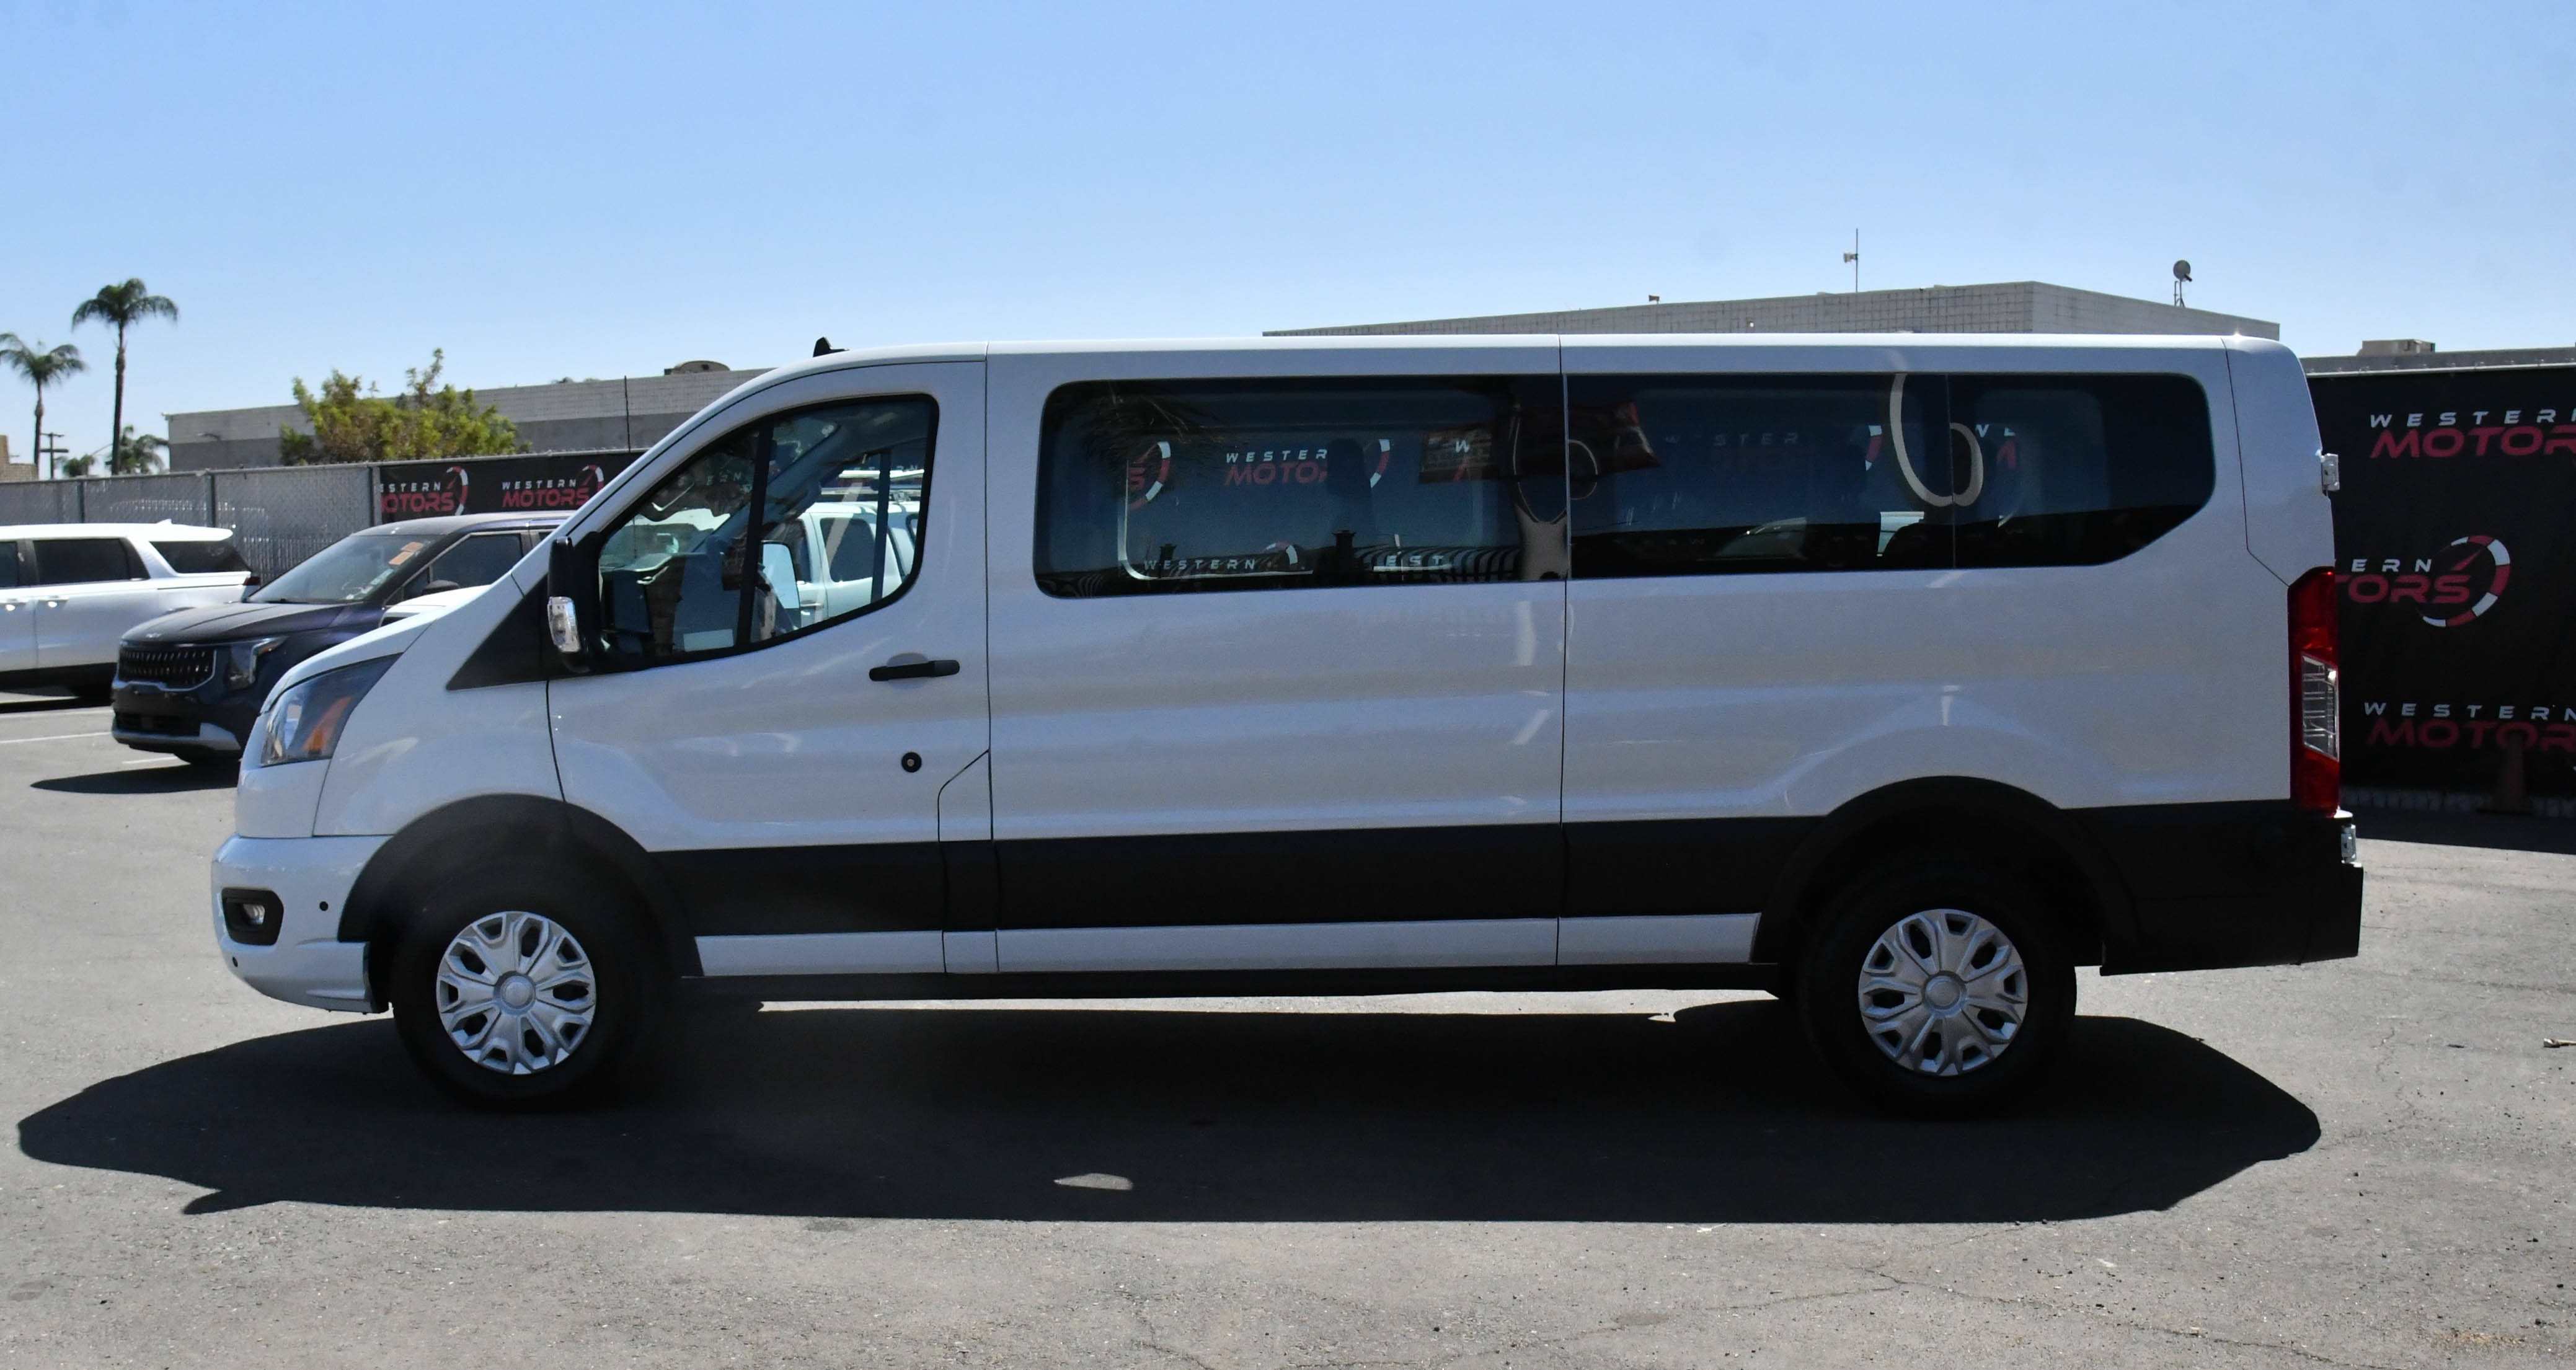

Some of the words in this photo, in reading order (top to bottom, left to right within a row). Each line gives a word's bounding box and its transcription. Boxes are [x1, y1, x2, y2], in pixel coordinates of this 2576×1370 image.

[2370, 408, 2576, 428] WESTER
[1226, 449, 1328, 464] WESTER
[502, 479, 577, 490] WESTERN
[501, 487, 590, 508] MOTORS
[1143, 559, 1255, 570] WESTERN
